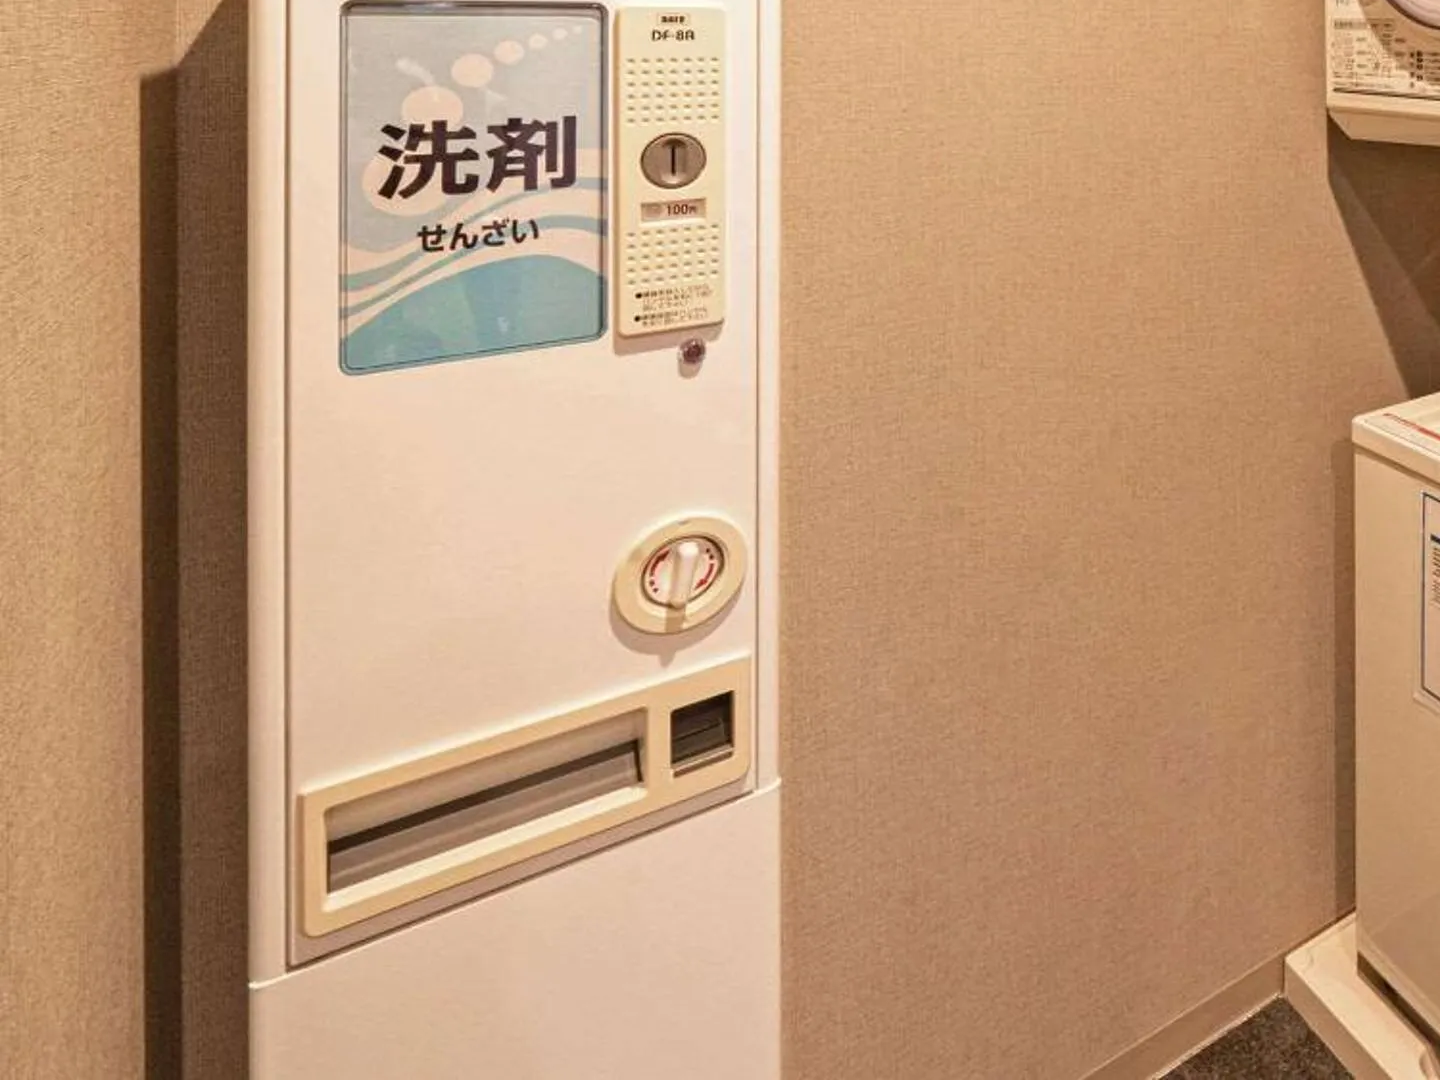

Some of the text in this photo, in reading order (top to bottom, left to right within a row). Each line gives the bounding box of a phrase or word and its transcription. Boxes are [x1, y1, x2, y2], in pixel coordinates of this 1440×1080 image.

[651, 28, 696, 42] DF-8A
[376, 115, 578, 200] 洗剤
[416, 217, 540, 254] せんざい
